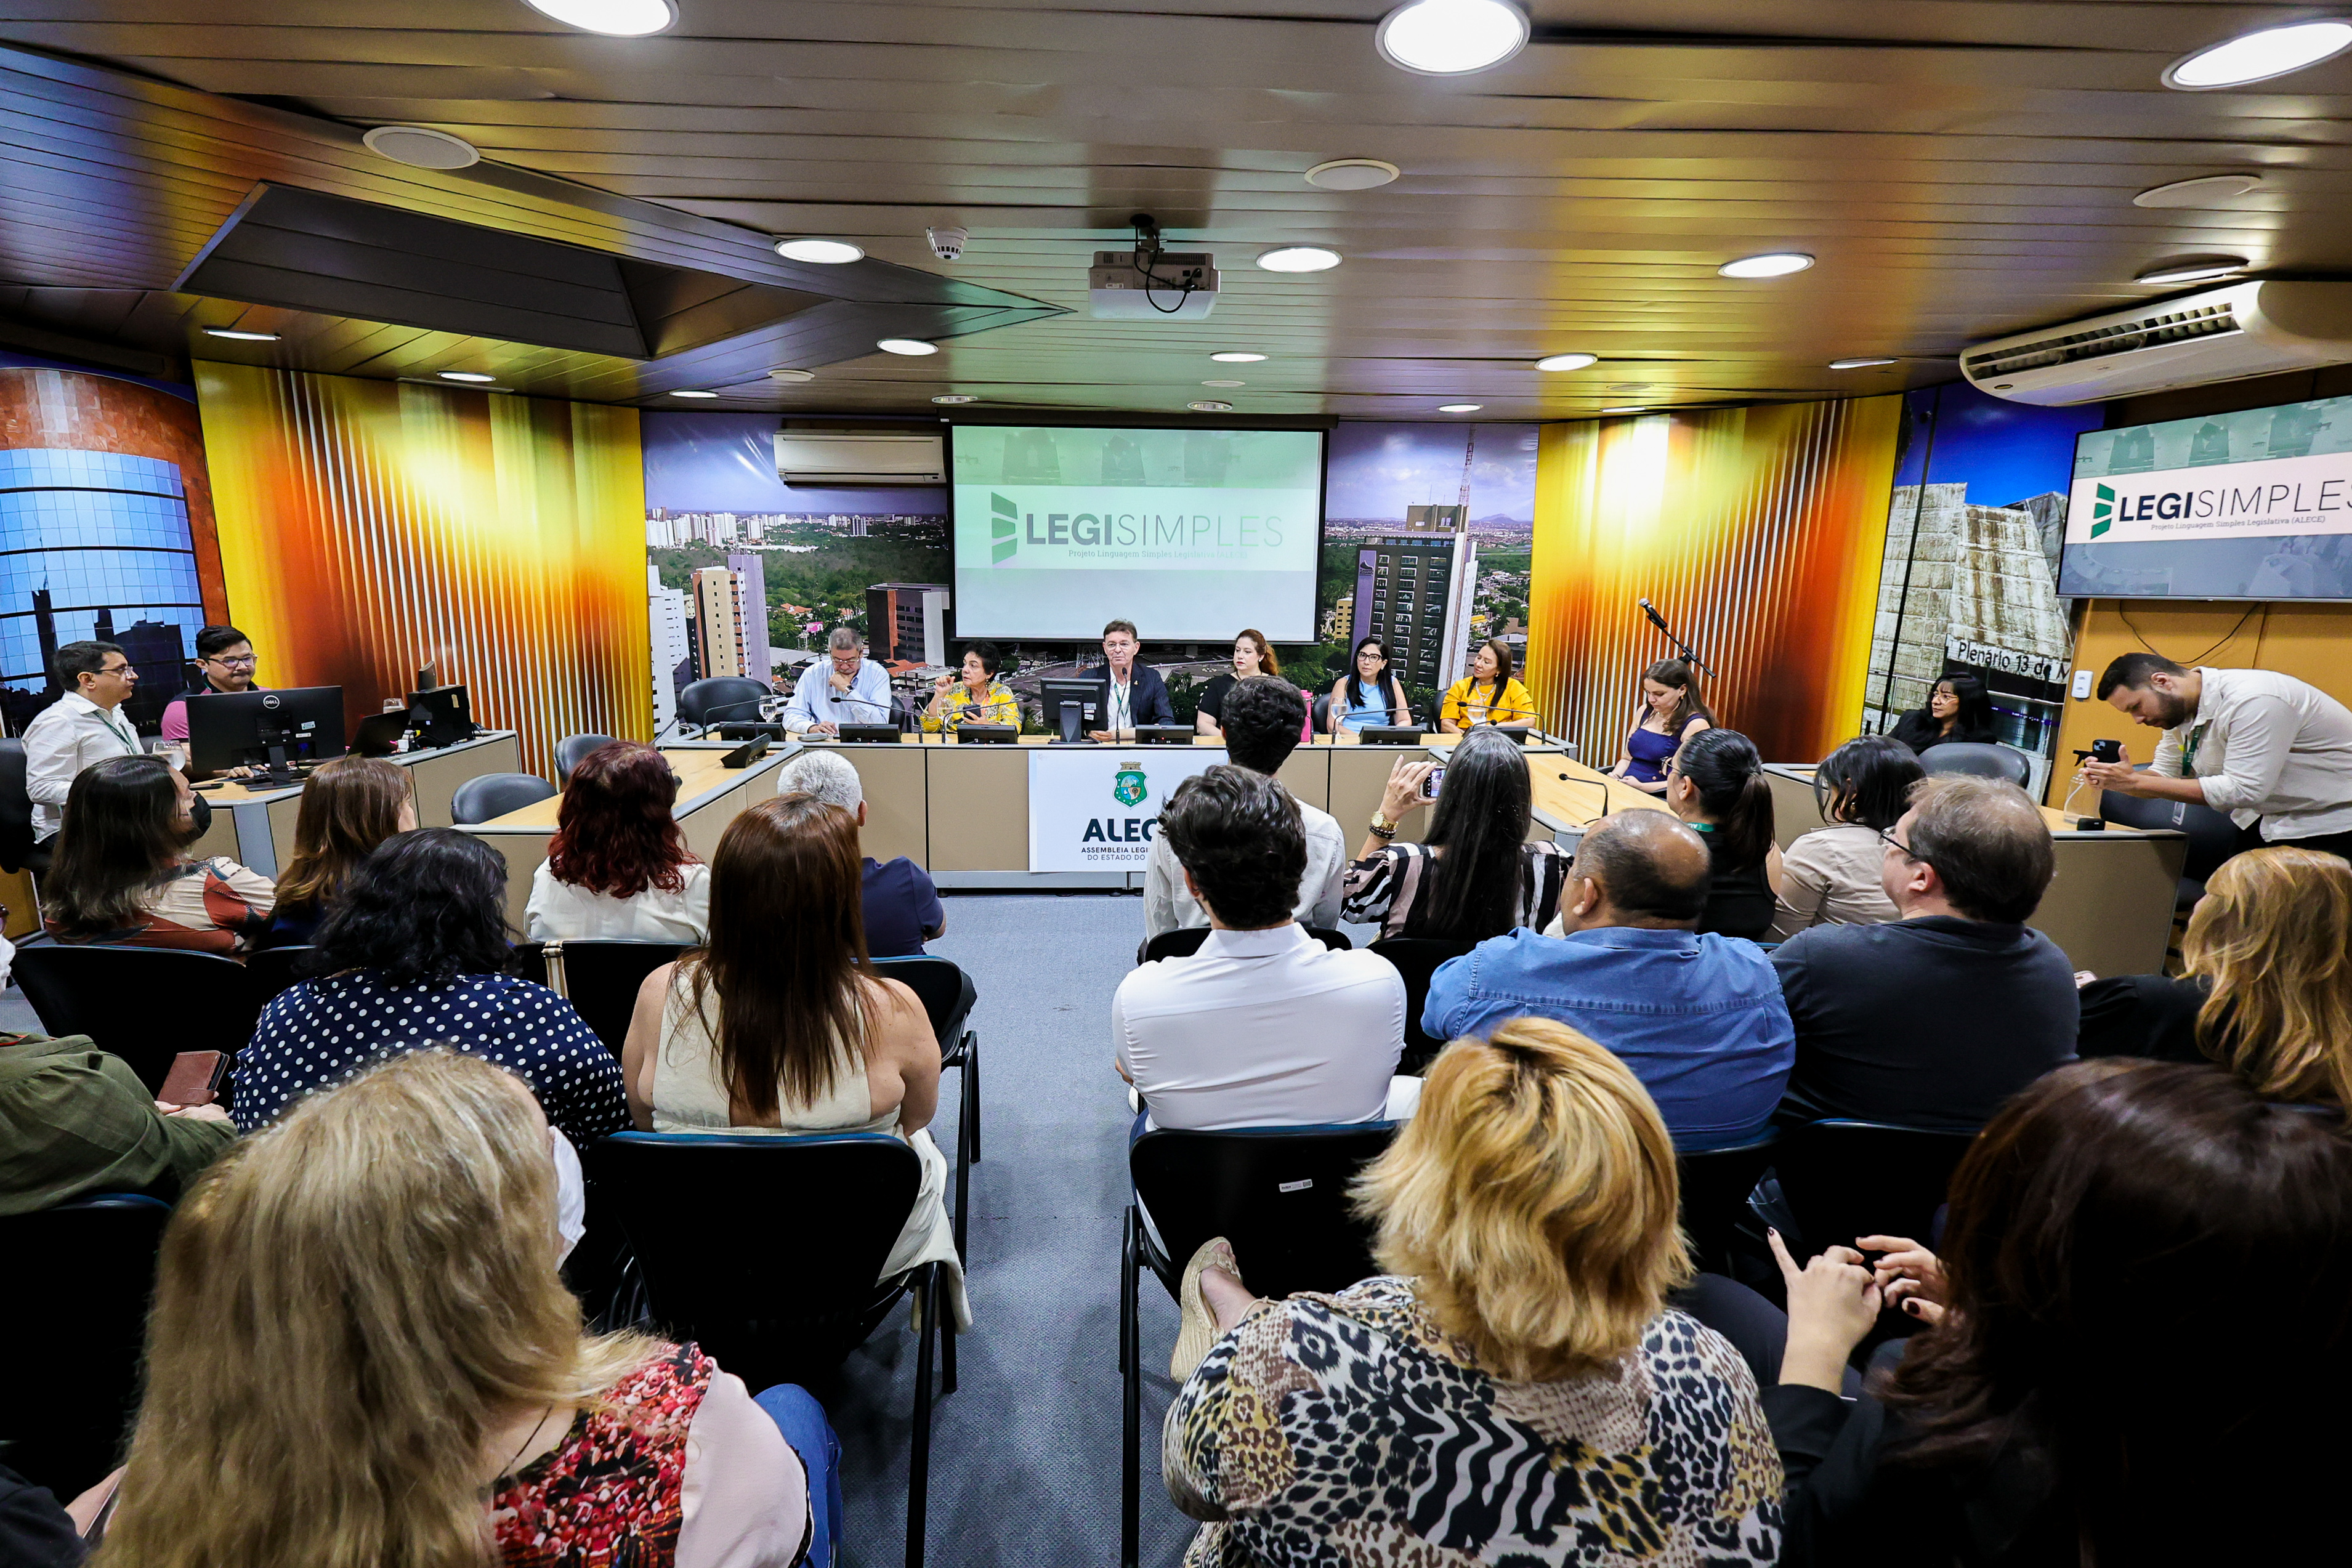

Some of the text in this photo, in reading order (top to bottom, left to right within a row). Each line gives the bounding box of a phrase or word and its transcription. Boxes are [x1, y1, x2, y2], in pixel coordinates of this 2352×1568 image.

[1026, 513, 1283, 547] LEGISIMPLES
[2175, 522, 2213, 530] Linguagem
[2216, 520, 2245, 528] Simples
[2247, 518, 2290, 527] Legislativa
[2291, 515, 2326, 525] (ALECE)
[1069, 549, 1096, 558] Projeto
[1097, 549, 1139, 558] Linguagem
[1141, 550, 1172, 559] Simples
[1174, 550, 1215, 559] Legislativa
[1958, 641, 2010, 669] Plenário
[2016, 655, 2029, 673] 13
